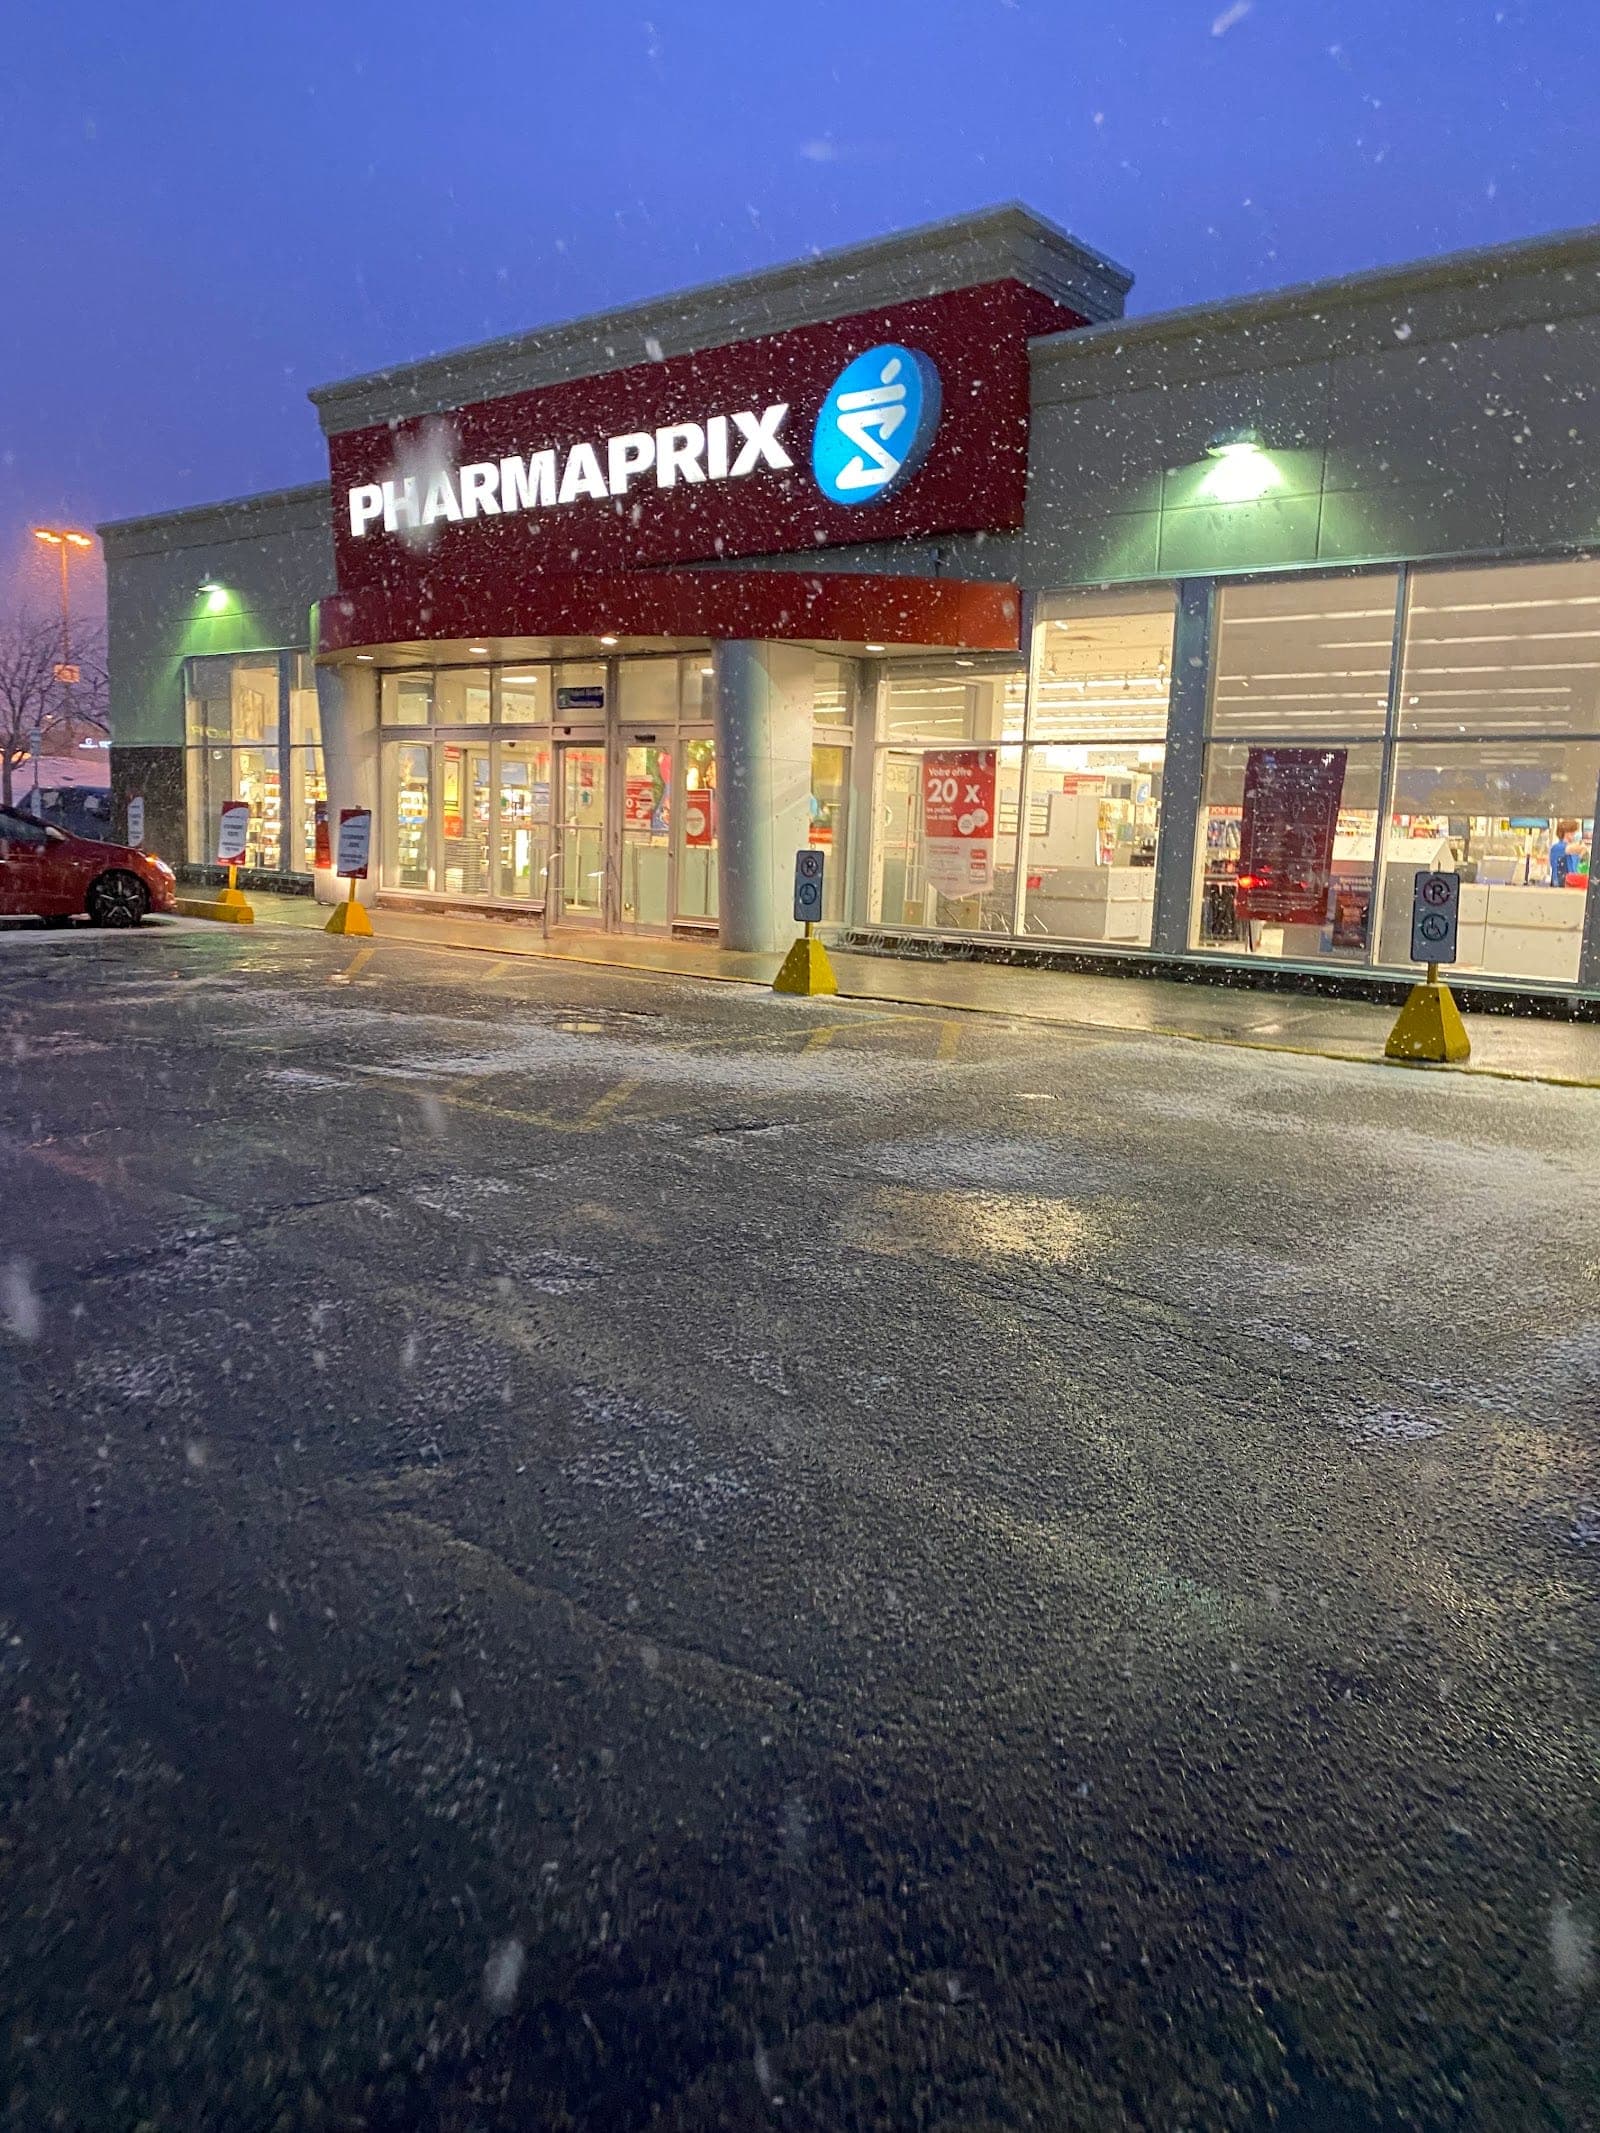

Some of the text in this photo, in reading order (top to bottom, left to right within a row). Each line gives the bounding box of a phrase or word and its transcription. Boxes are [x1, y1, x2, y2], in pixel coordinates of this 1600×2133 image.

[349, 403, 793, 537] PHARMAPRIX
[928, 767, 950, 776] Votre
[927, 778, 958, 803] 20
